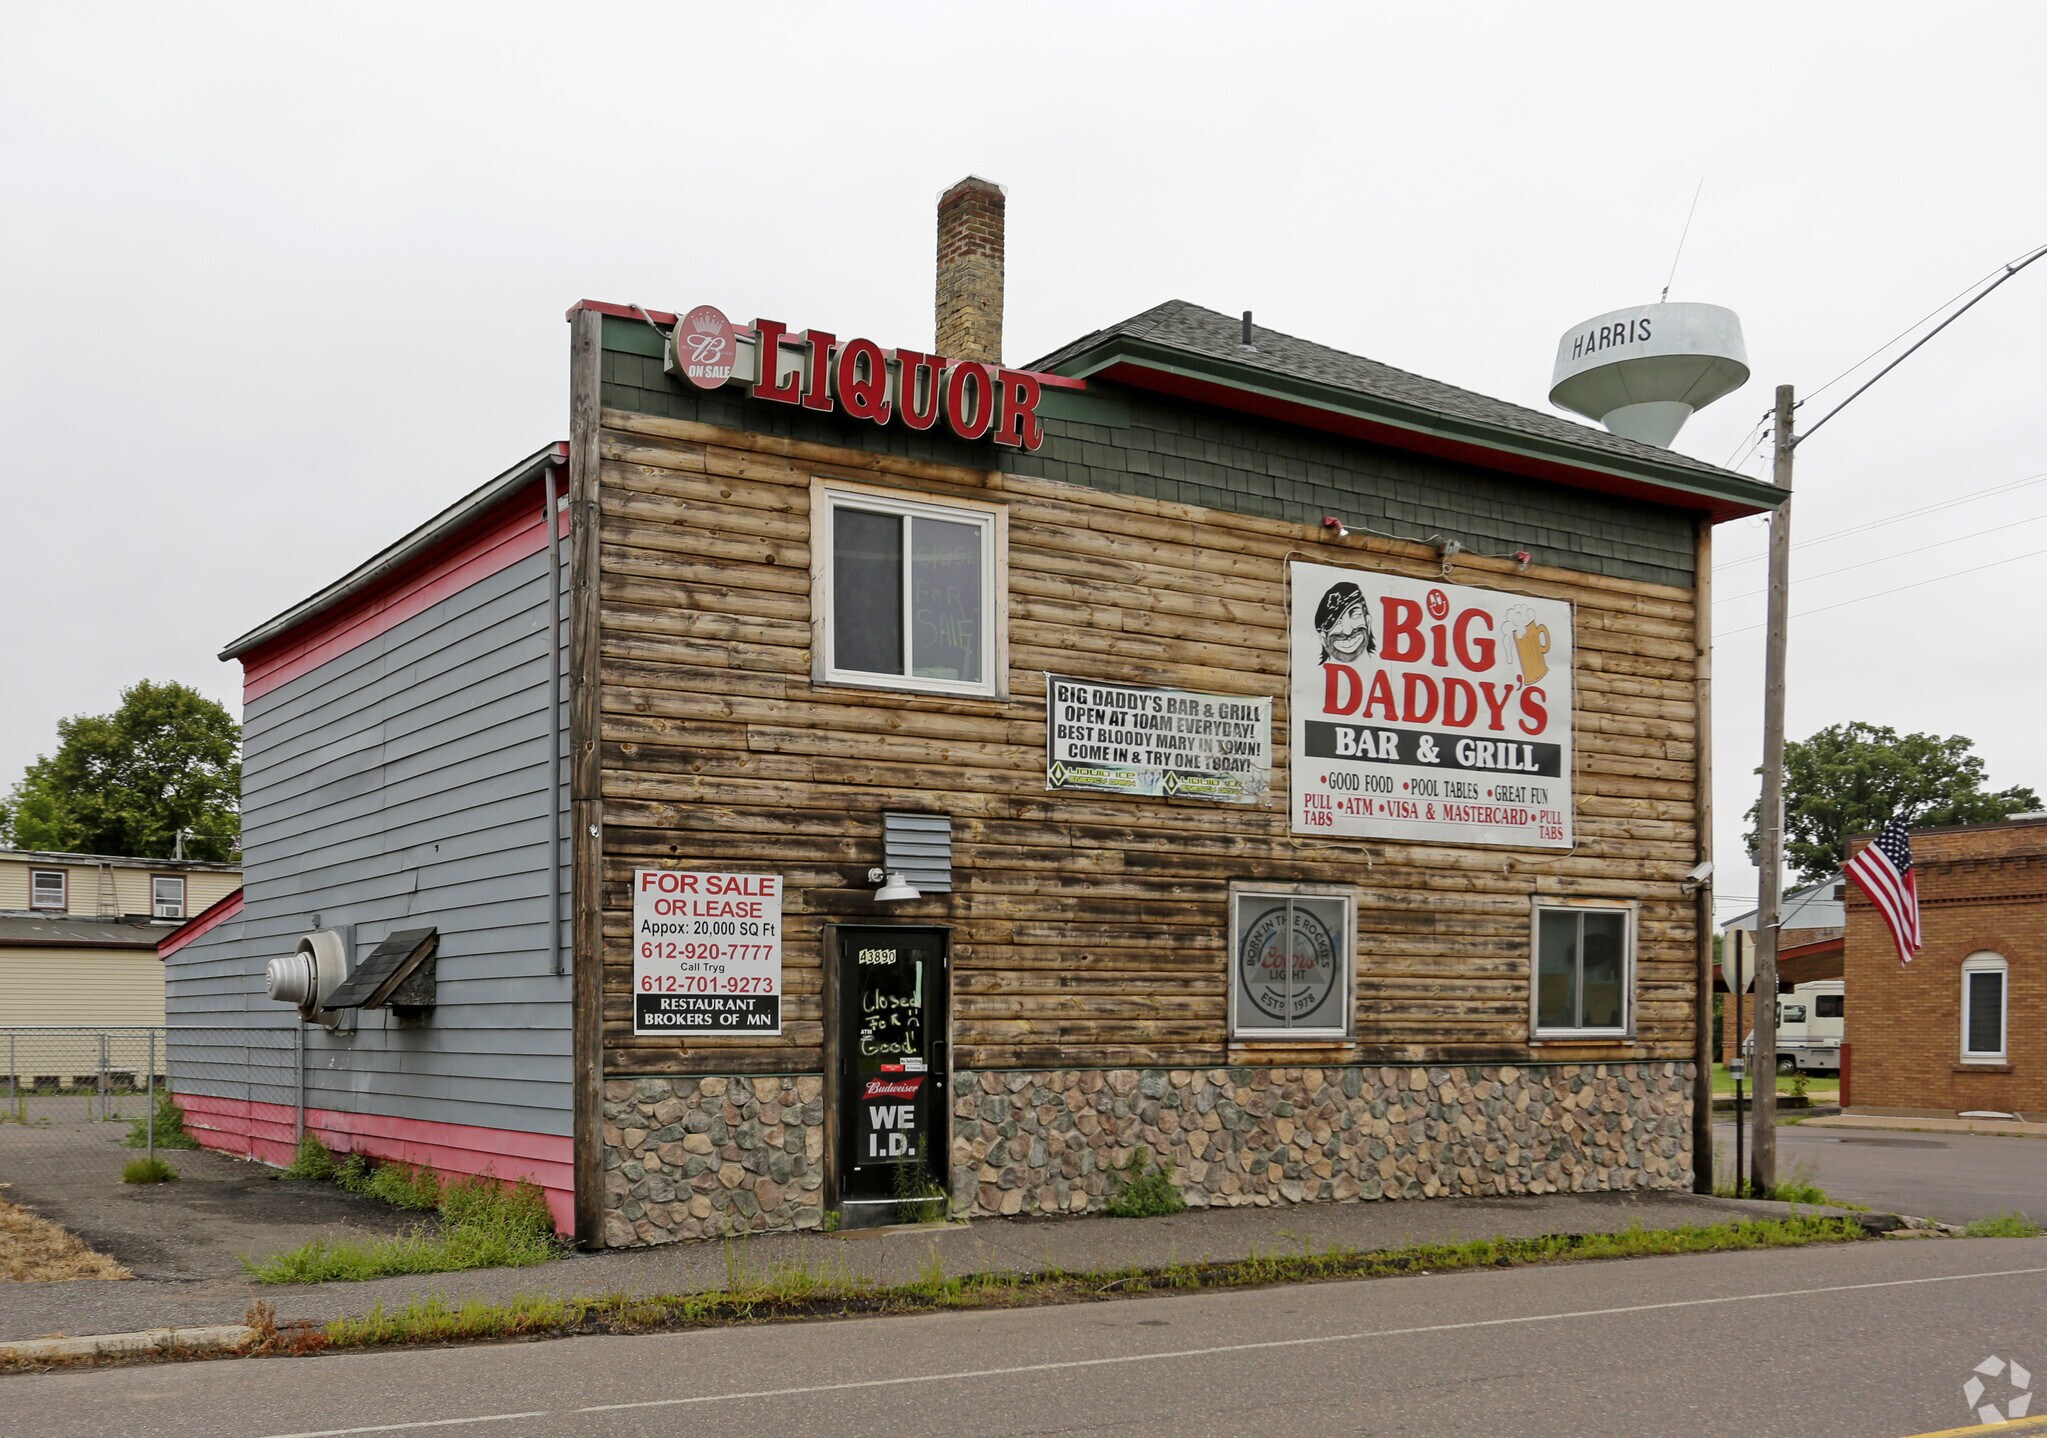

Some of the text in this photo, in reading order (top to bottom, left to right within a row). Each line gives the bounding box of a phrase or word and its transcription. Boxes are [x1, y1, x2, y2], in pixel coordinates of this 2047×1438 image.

[1571, 318, 1652, 361] HARRIS
[688, 365, 731, 379] ON SALE
[752, 318, 1044, 450] LIQUOR
[1057, 685, 1261, 722] BIG DADDY'S BAR & GRILL
[1322, 663, 1548, 736] DADDY'S
[1065, 705, 1255, 739] OPEN AT 10AM EVERYDAY!
[1057, 724, 1261, 757] BEST BLOODY MARY IN TOWN!
[1335, 727, 1539, 772] BAR & GRILL
[1068, 743, 1251, 773] COME IN & TRY ONE TODAY!
[1068, 767, 1110, 778] LIQUID
[1328, 772, 1549, 804] GOOD FOOD POOL TABLES GREAT FUN
[1303, 793, 1563, 825] PULL ATM VISA & MASTERCARD PULL
[1303, 810, 1333, 827] TABS
[1540, 825, 1563, 840] TABS
[641, 873, 775, 897] FOR SALE
[654, 899, 762, 918] OR LEASE
[641, 919, 775, 937] Appox: 20,000 SQ Ft
[641, 942, 773, 960] 612-920-7777
[1247, 930, 1264, 966] BORN
[1261, 919, 1275, 933] IN
[1302, 919, 1330, 968] ROCKIES
[860, 950, 896, 963] 43890
[680, 962, 725, 973] Call Tryg
[1269, 969, 1306, 981] LIGHT
[641, 975, 773, 993] 612-701-9273
[660, 998, 756, 1010] RESTAURANT
[863, 988, 918, 1012] Closed
[1293, 992, 1315, 1011] 1978
[644, 1013, 771, 1025] BROKERS OF MN
[866, 1081, 918, 1094] Budweiser
[869, 1105, 915, 1129] WE
[869, 1132, 916, 1157] I.D.
